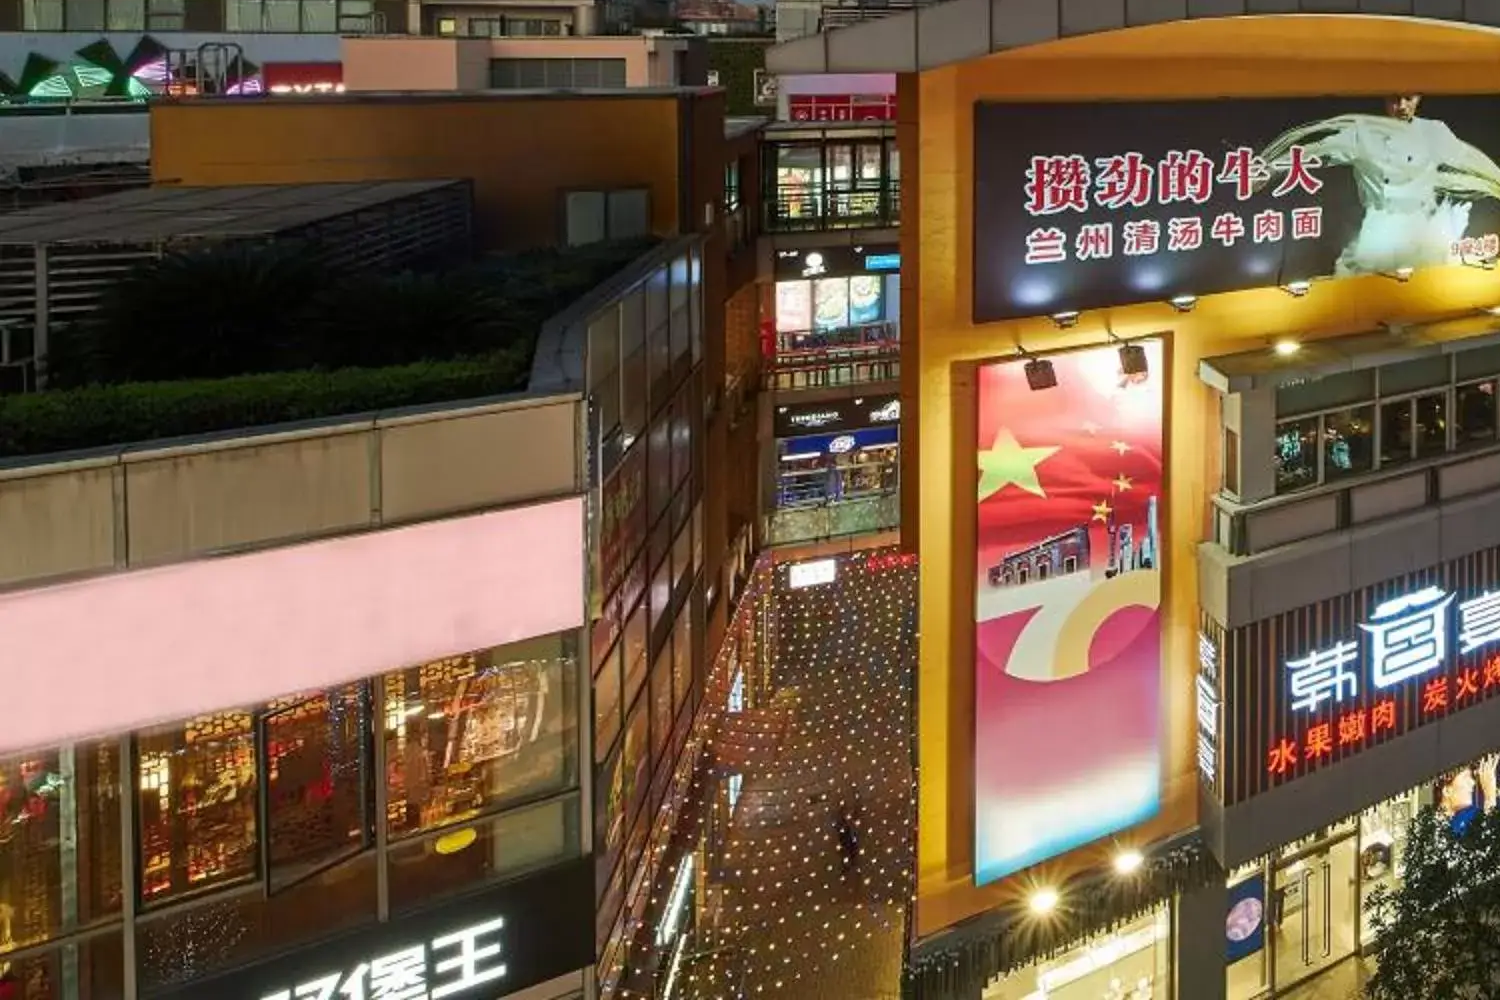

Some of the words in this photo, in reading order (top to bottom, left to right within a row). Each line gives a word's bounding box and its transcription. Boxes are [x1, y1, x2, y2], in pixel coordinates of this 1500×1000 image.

[1024, 145, 1323, 215] 攒劲的牛大
[1025, 207, 1324, 264] 兰州清汤牛肉面
[1267, 698, 1397, 775] 水果嫩肉
